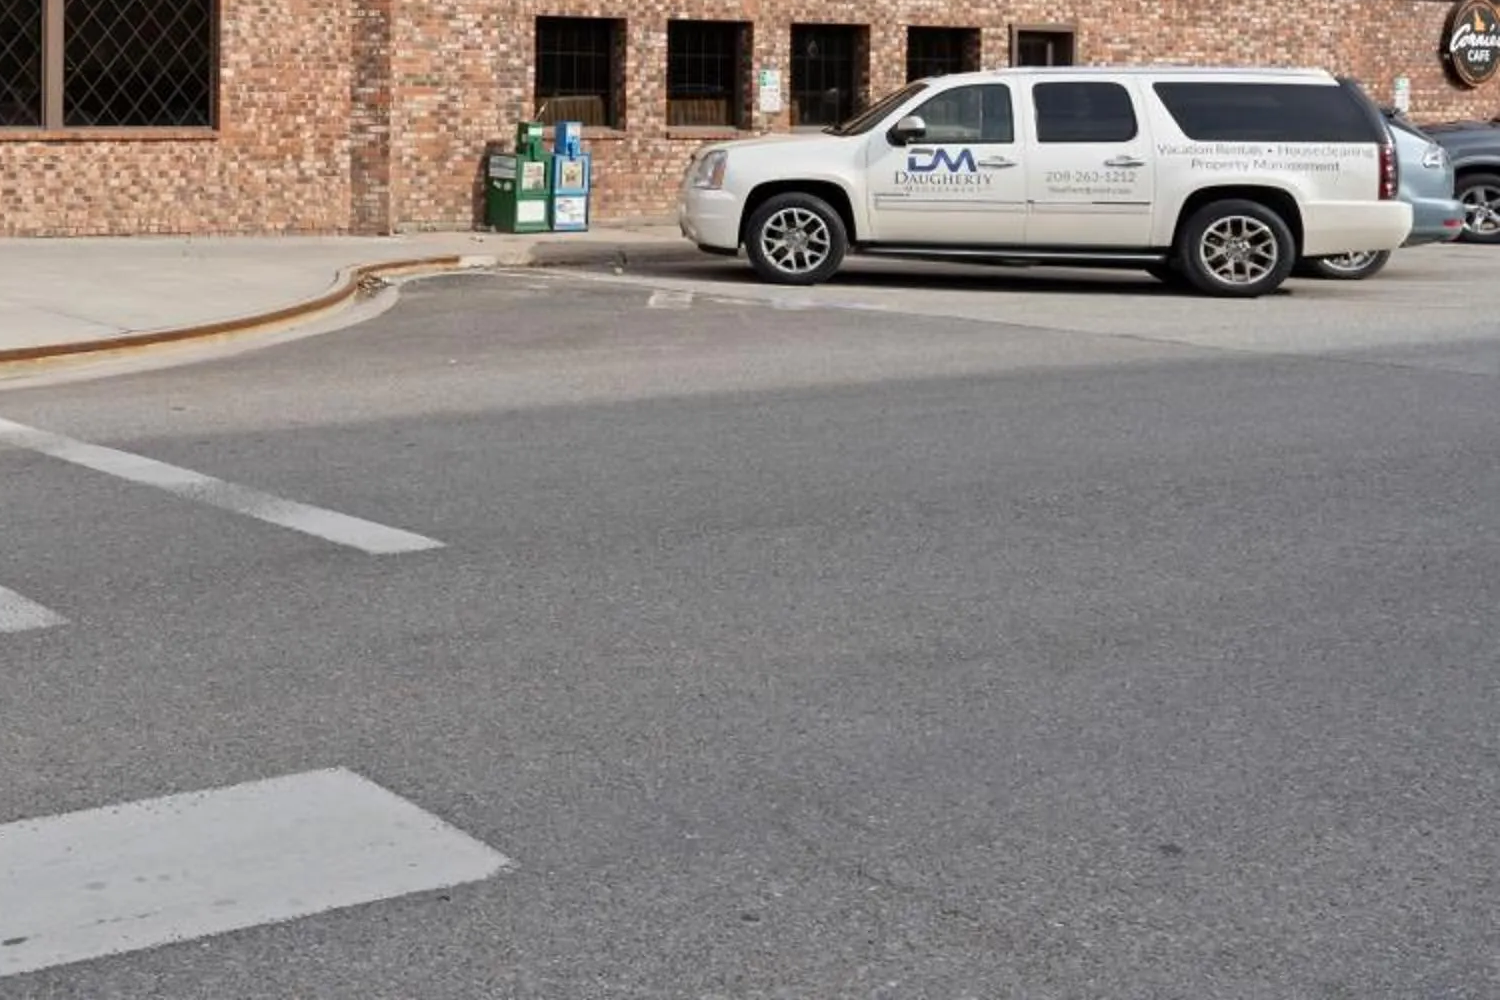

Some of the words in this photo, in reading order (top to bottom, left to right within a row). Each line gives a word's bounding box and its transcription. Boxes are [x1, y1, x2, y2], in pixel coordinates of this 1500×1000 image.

[1467, 49, 1491, 62] CAFE
[1157, 143, 1213, 156] Vacation
[908, 148, 977, 172] DM
[1190, 159, 1249, 172] Property
[1253, 160, 1340, 173] Management
[895, 170, 994, 185] DAUGHERTY
